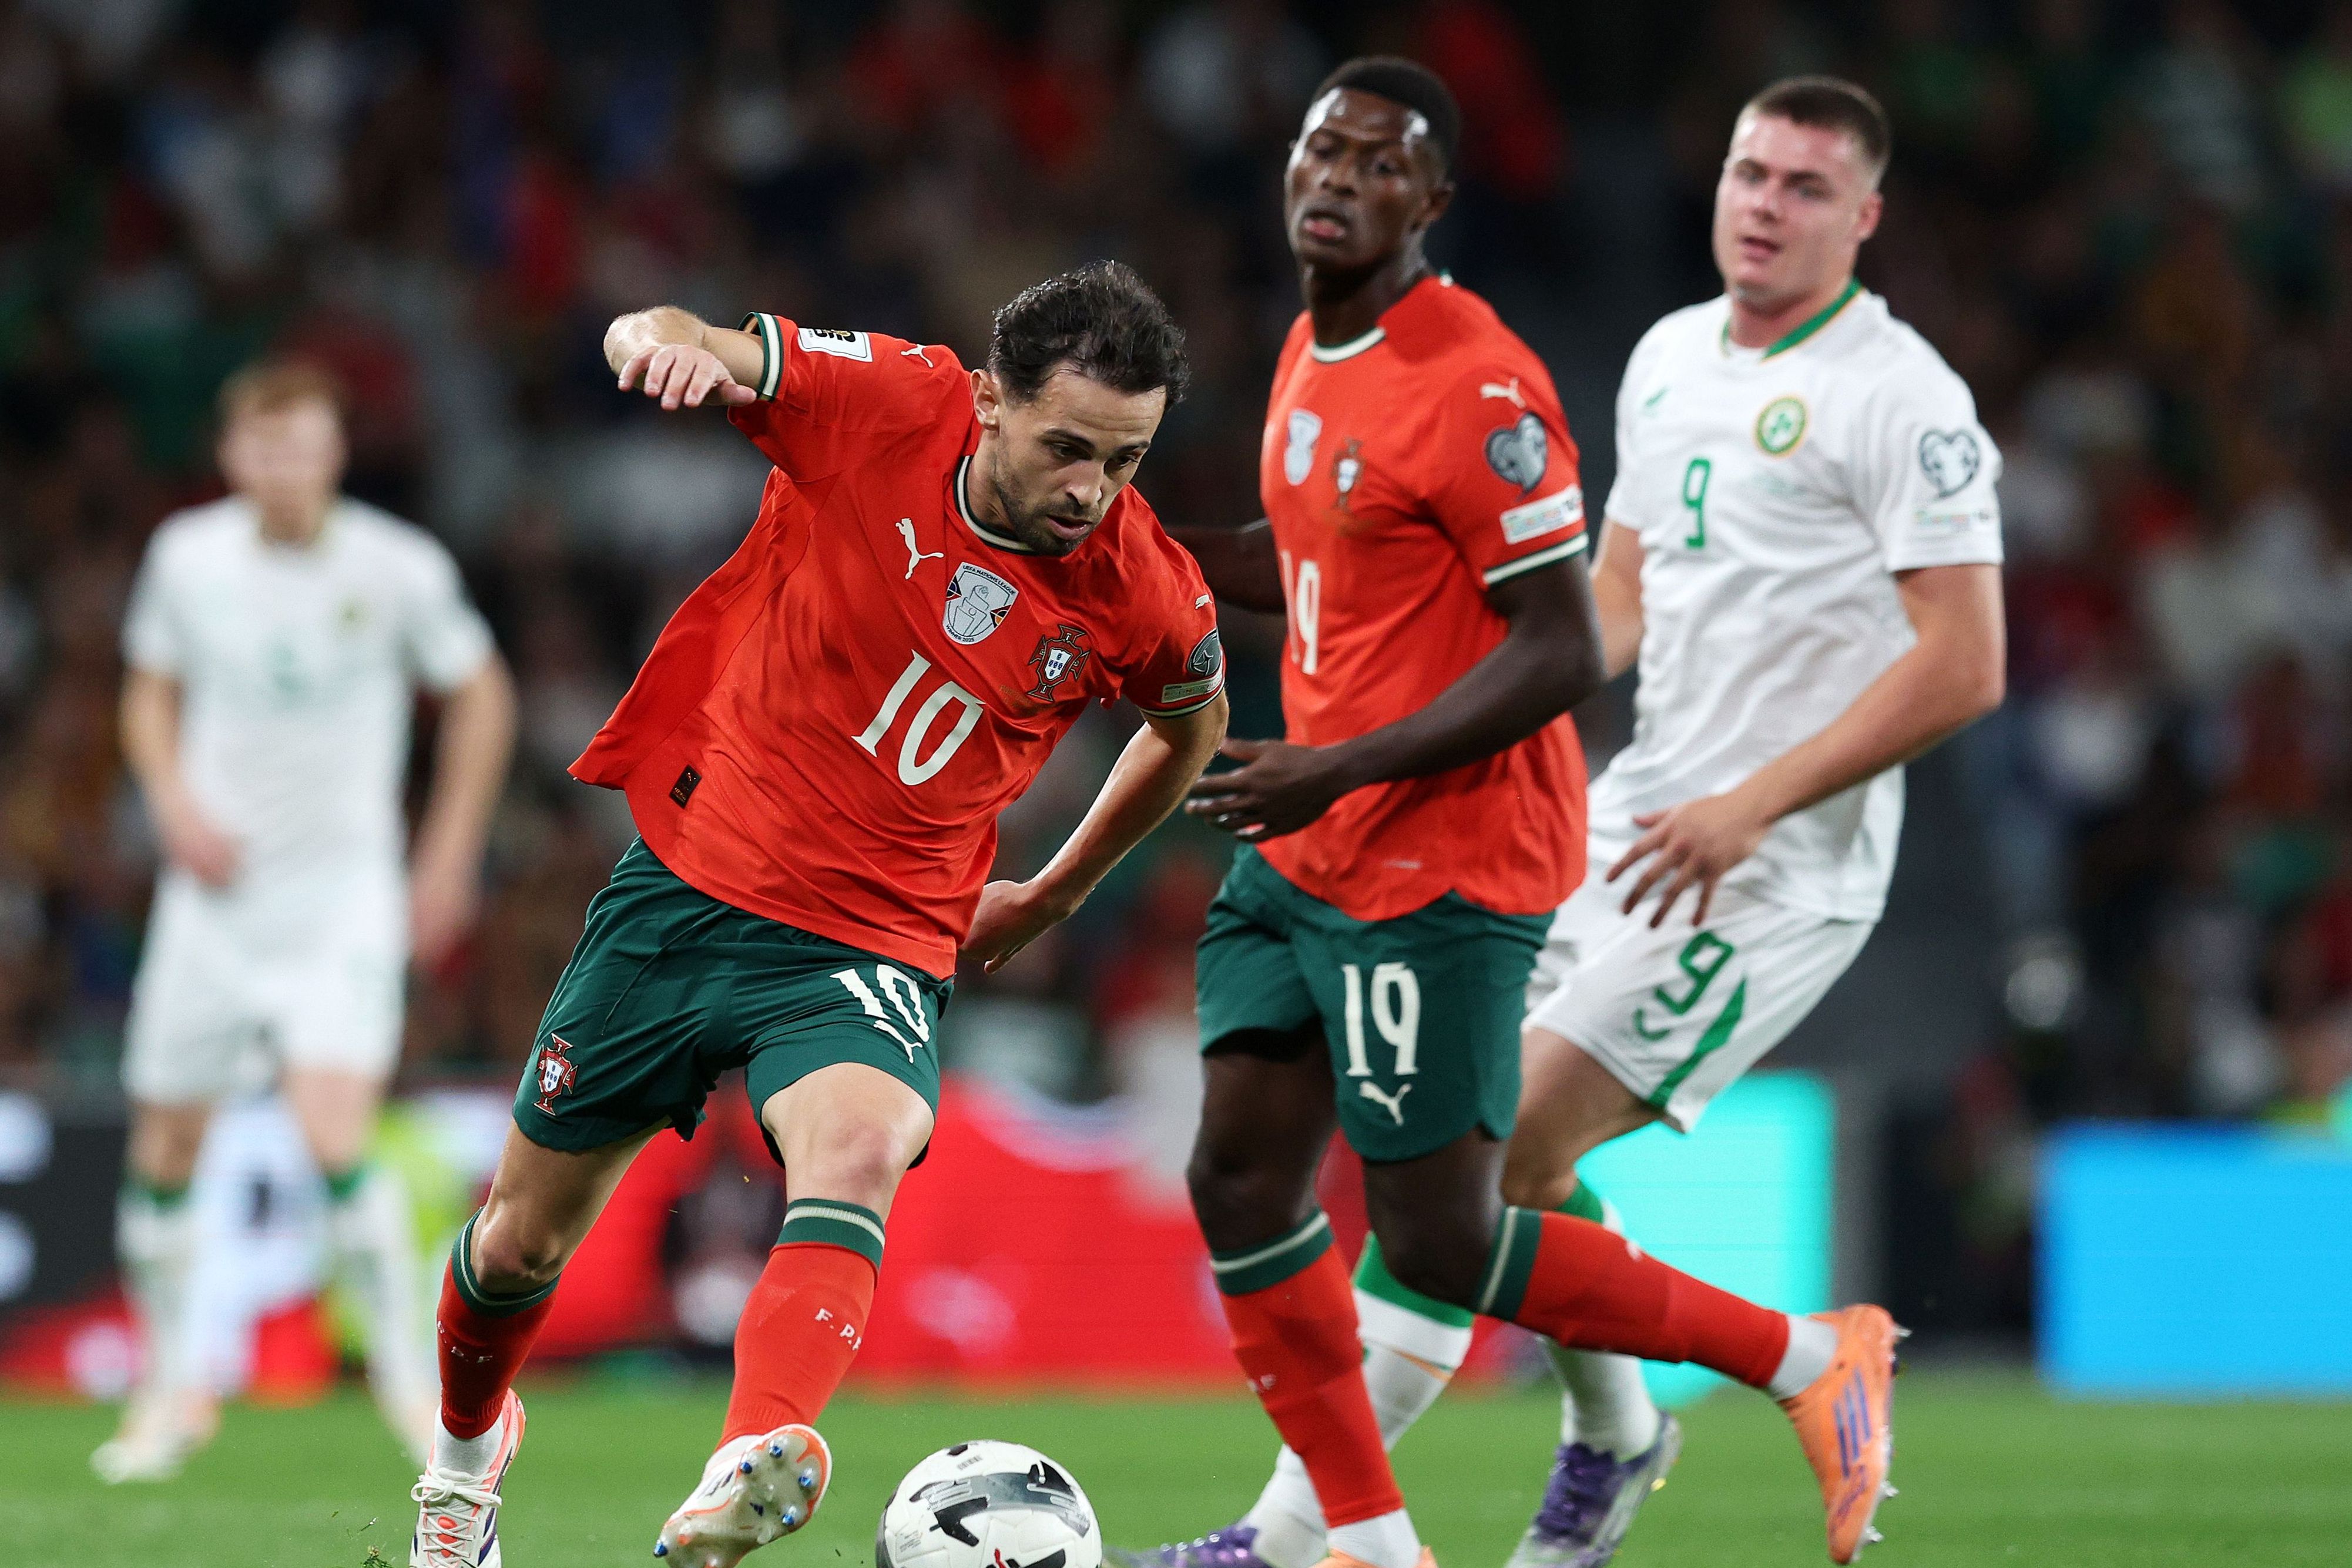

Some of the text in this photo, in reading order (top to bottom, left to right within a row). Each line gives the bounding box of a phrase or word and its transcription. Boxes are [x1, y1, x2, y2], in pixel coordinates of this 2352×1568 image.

[1681, 456, 1712, 550] 9
[962, 565, 1016, 595] UEFA NATIONS LEAGUE
[1281, 549, 1321, 676] 19
[851, 650, 986, 785] 10
[829, 963, 930, 1043] 10
[1342, 962, 1421, 1077] 19
[1655, 932, 1736, 1017] 9
